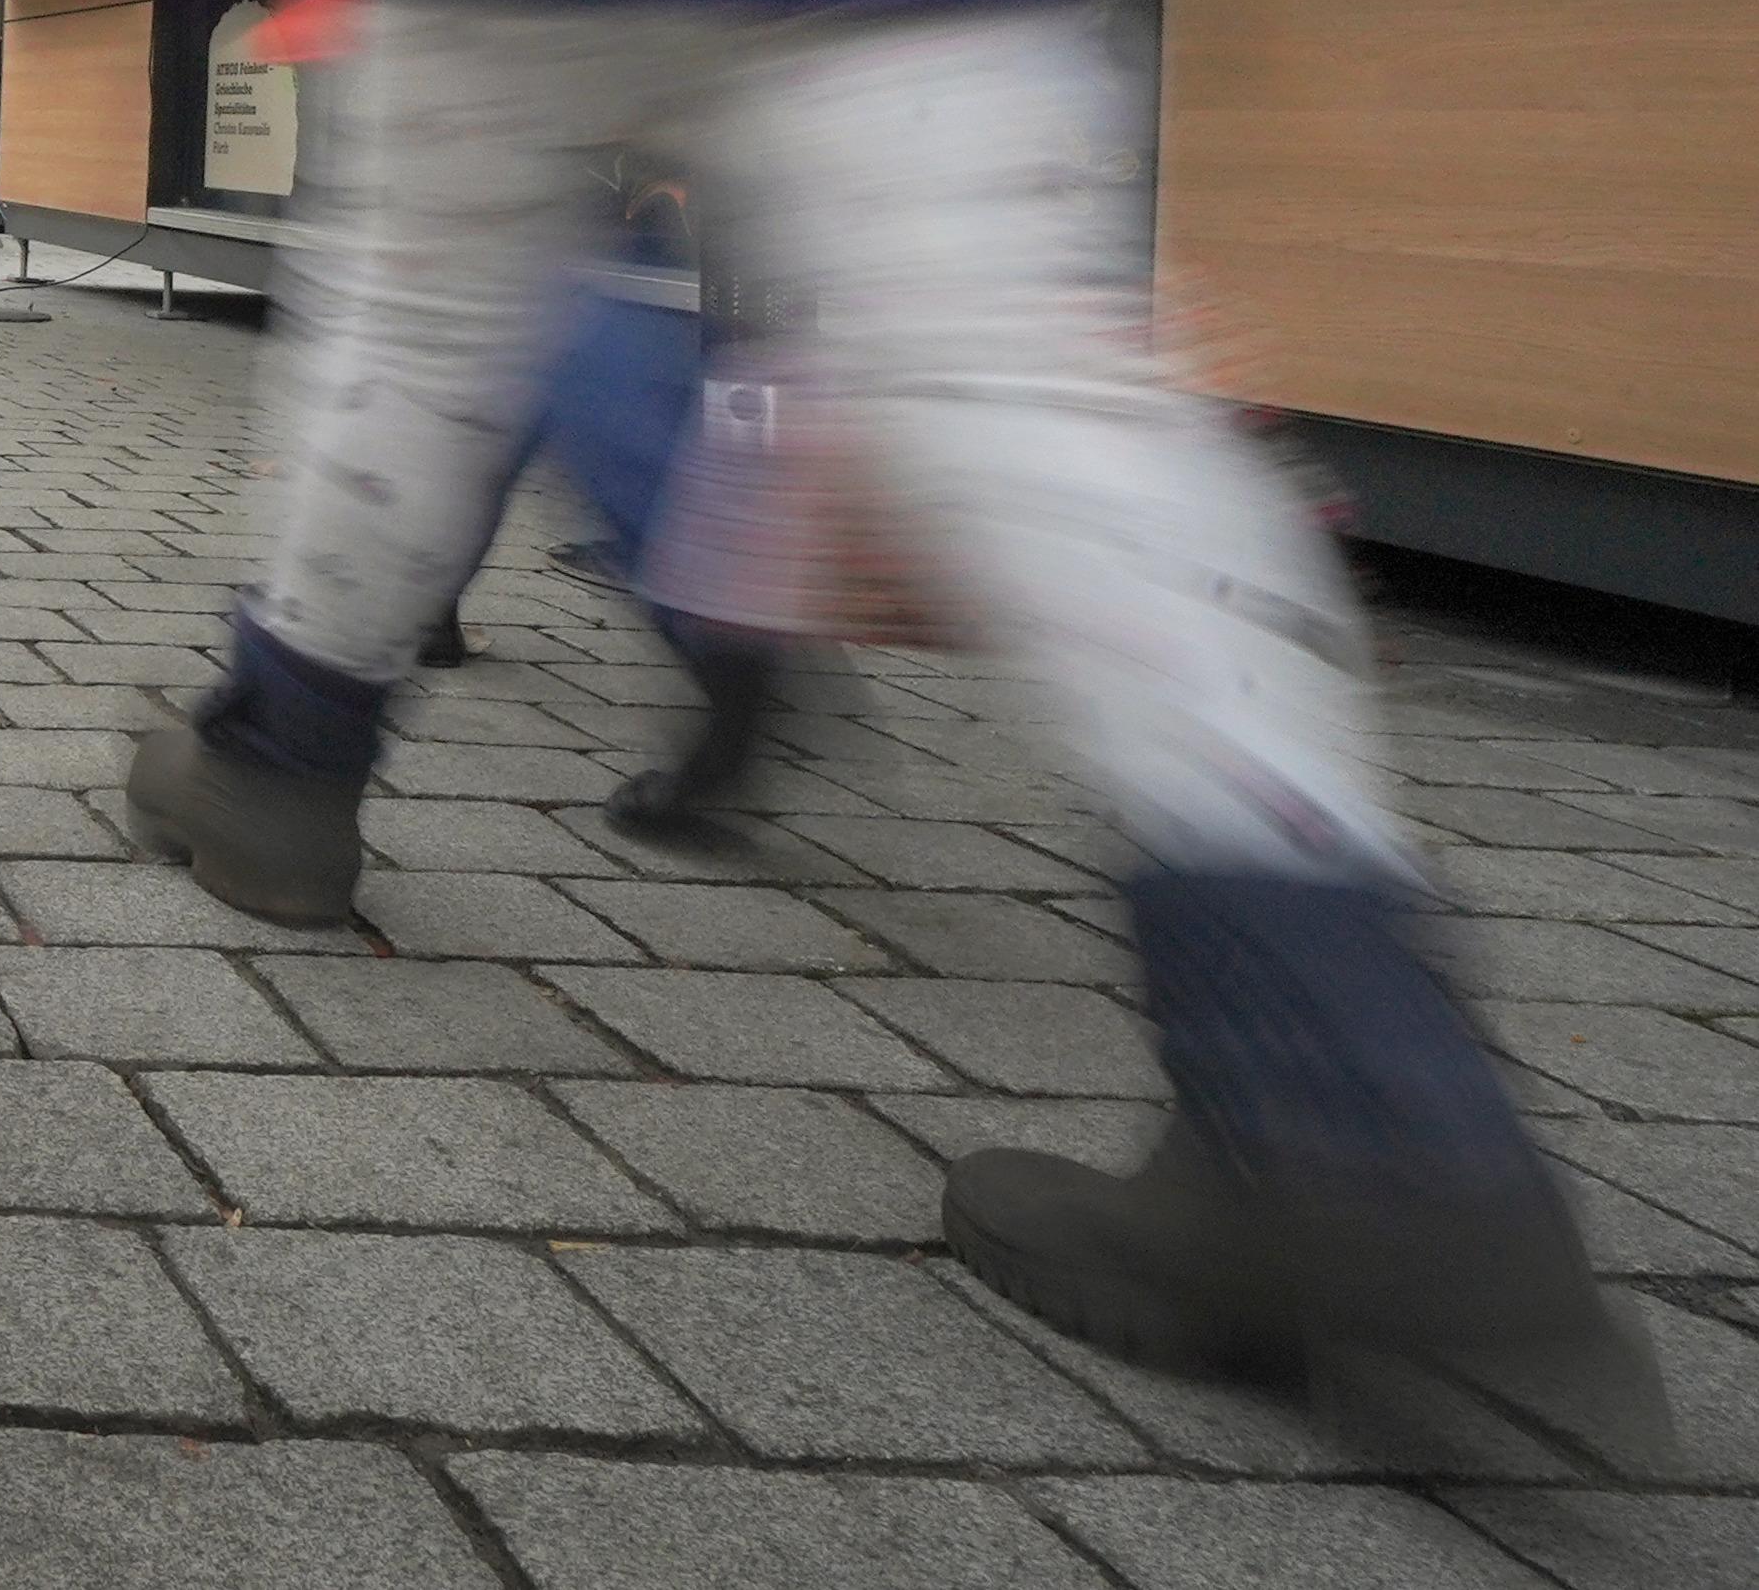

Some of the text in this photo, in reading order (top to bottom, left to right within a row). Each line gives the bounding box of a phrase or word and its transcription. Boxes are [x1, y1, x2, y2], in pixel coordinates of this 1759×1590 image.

[239, 61, 268, 75] Feinkost
[215, 81, 253, 95] Griechische
[214, 101, 257, 118] Spezialitäten
